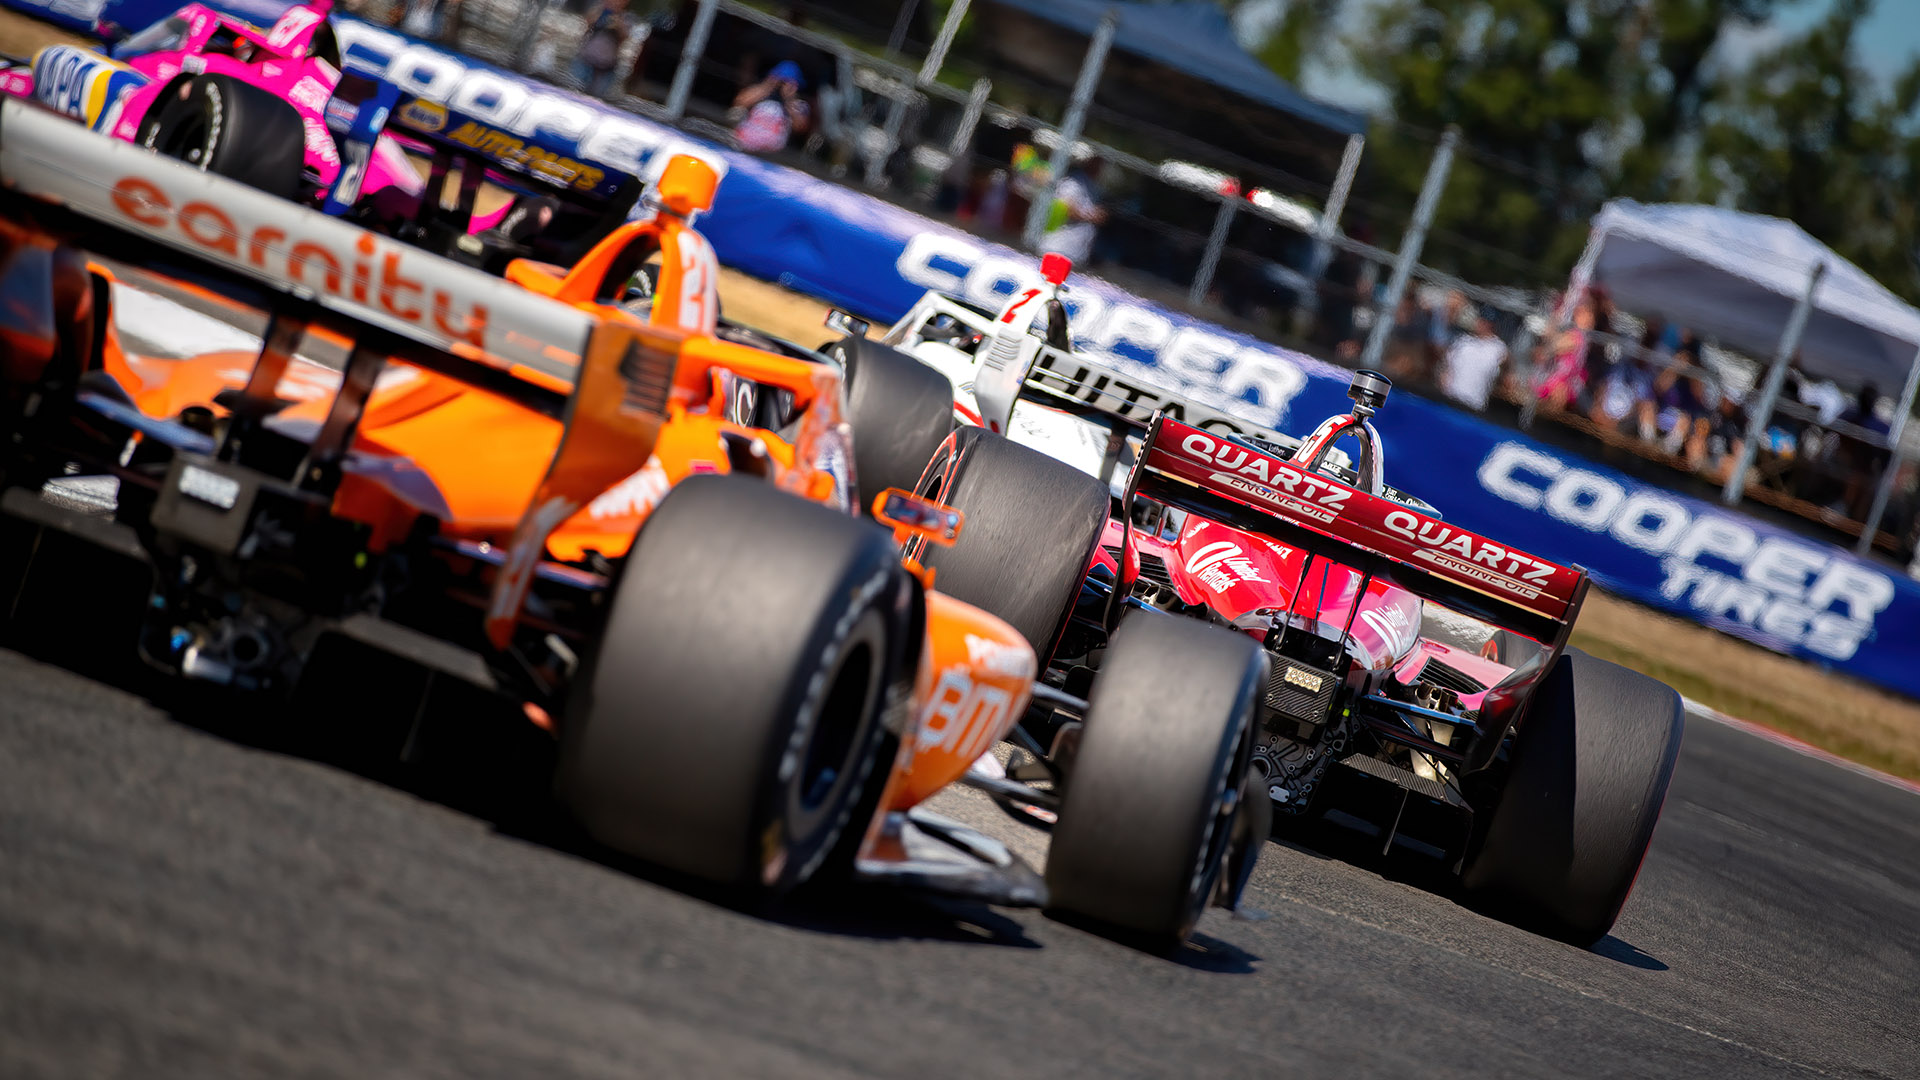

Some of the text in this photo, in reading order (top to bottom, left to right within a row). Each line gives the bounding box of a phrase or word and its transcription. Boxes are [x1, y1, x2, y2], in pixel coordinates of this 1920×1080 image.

[1001, 289, 1042, 324] 2
[1182, 434, 1353, 511] QUARTZ
[1230, 478, 1299, 507] ENGINE
[1301, 499, 1329, 521] OIL
[1384, 511, 1557, 587] QUARTZ
[1477, 440, 1895, 625] COOPER
[1196, 561, 1241, 594] Rentals
[1222, 557, 1272, 584] United
[1433, 556, 1533, 597] ENGINE OIL
[1660, 556, 1873, 662] TIRES
